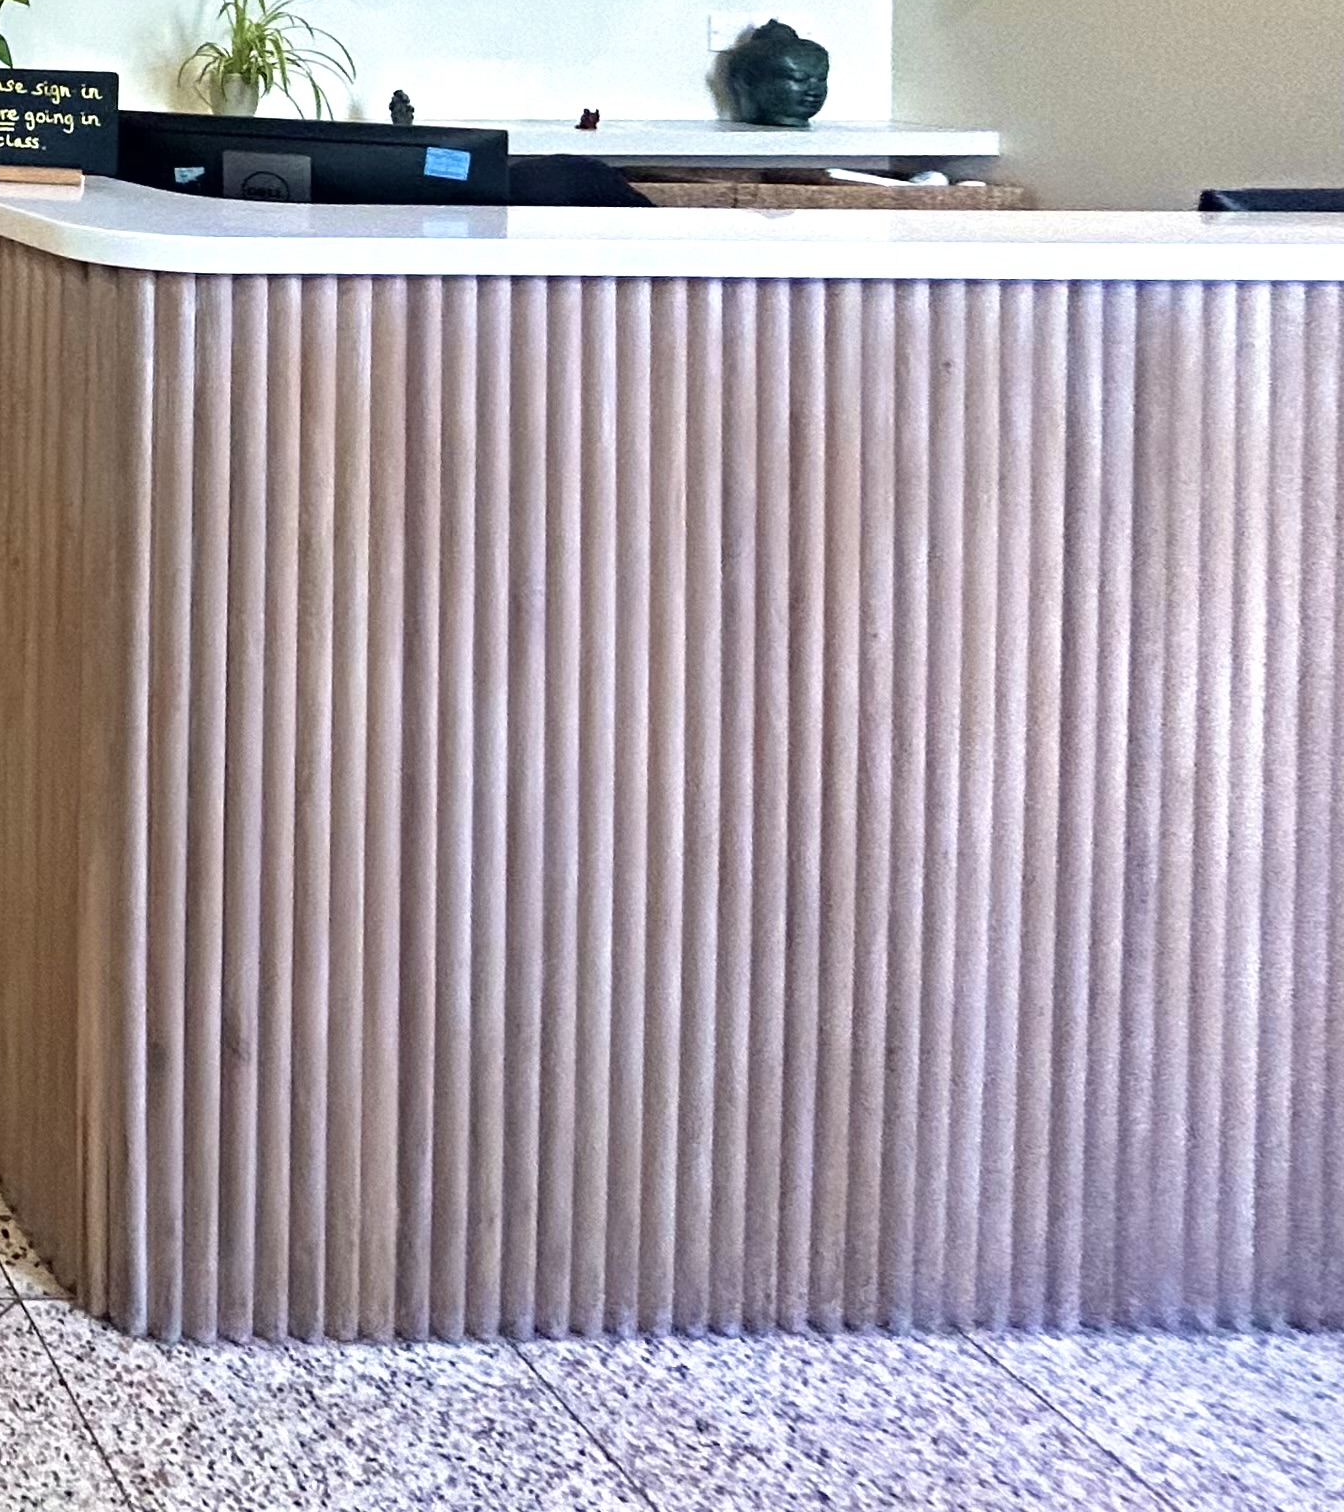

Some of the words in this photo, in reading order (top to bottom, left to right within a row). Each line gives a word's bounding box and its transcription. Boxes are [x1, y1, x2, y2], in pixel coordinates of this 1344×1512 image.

[30, 79, 72, 105] sign
[80, 83, 104, 101] in
[23, 109, 76, 135] going
[80, 110, 102, 128] in
